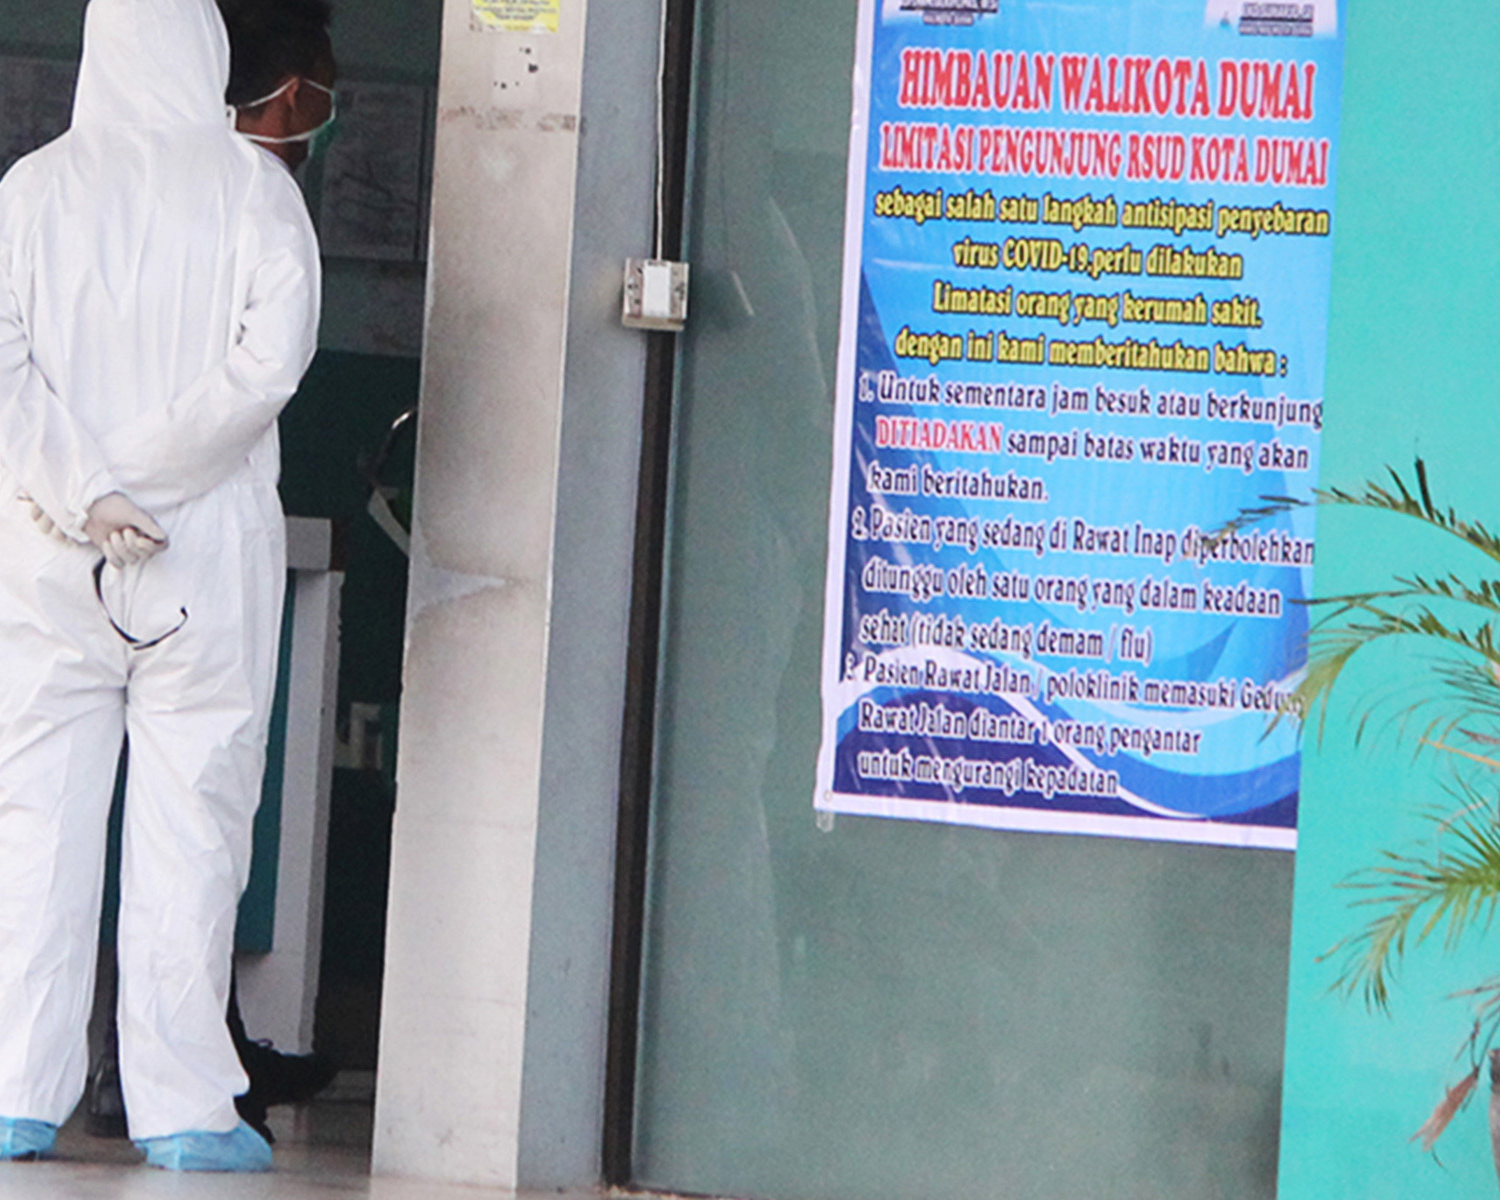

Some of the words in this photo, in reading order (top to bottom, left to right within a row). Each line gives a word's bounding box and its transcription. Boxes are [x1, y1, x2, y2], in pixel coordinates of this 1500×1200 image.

[900, 49, 1055, 110] HIMBAUAN
[1061, 54, 1209, 117] WALIKOTA
[1218, 61, 1315, 120] DUMAI
[881, 124, 974, 171] LIMITASI
[978, 127, 1121, 177] PENGUNJUNG
[1127, 134, 1185, 180] RSUD
[1190, 137, 1249, 182] KOTA
[1255, 139, 1329, 186] DUMAI
[875, 187, 942, 224] sebagai
[946, 189, 995, 221] salah
[999, 194, 1038, 223] satu
[1042, 192, 1117, 231] langkah
[1122, 197, 1213, 235] antisipasi
[1217, 202, 1329, 239] penyebaran
[953, 236, 999, 268] virus
[1146, 244, 1242, 279] dilakukan
[933, 280, 1011, 314] Limatasi
[1016, 291, 1070, 325] orang
[1073, 292, 1119, 328] yang
[1123, 289, 1207, 325] kerumah
[896, 325, 962, 365] dengan
[967, 330, 993, 361] ini
[998, 331, 1045, 362] kami
[1049, 335, 1209, 372] memberitahukan
[1214, 341, 1276, 375] bahwa
[880, 373, 940, 402] Untuk
[945, 382, 1046, 408] sementara
[1052, 384, 1088, 413] jam
[1096, 387, 1150, 413] besuk
[1157, 392, 1200, 416] atau
[1207, 393, 1323, 429] berkunjung
[876, 418, 1002, 451] DITIADAKAN
[1007, 431, 1078, 461] sampai
[1084, 433, 1133, 459] batas
[1140, 436, 1200, 463] waktu
[1206, 444, 1253, 471] yang
[1259, 442, 1308, 468] akan
[870, 464, 917, 491] kami
[872, 508, 931, 540] Pasien
[935, 520, 978, 550] yang
[983, 518, 1045, 555] sedang
[1050, 521, 1067, 549] di
[1074, 521, 1129, 552] Rawat
[1135, 524, 1176, 562] Inap
[865, 559, 943, 598] ditunggu
[948, 567, 987, 596] oleh
[992, 573, 1029, 598] satu
[1035, 579, 1087, 609] orang
[1092, 582, 1134, 613] yang
[1140, 578, 1197, 609] dalam
[1203, 582, 1280, 615] keadaan
[861, 612, 906, 643] sehat
[911, 615, 965, 647] (tidak
[970, 622, 1032, 657] sedang
[1037, 624, 1102, 656] demam
[864, 654, 918, 685] Pasien
[925, 660, 979, 688] Rawat
[985, 664, 1030, 693] Jalan
[1047, 671, 1138, 702] poloklinik
[1144, 680, 1235, 707] memasuki
[861, 701, 915, 731] Rawat
[919, 704, 967, 735] Jalan
[970, 709, 1033, 740] diantar
[1054, 720, 1104, 752] orang
[1110, 726, 1200, 755] pengantar
[859, 749, 911, 779] untuk
[916, 756, 1021, 794] mengurangi
[1026, 761, 1117, 796] kepadatan
